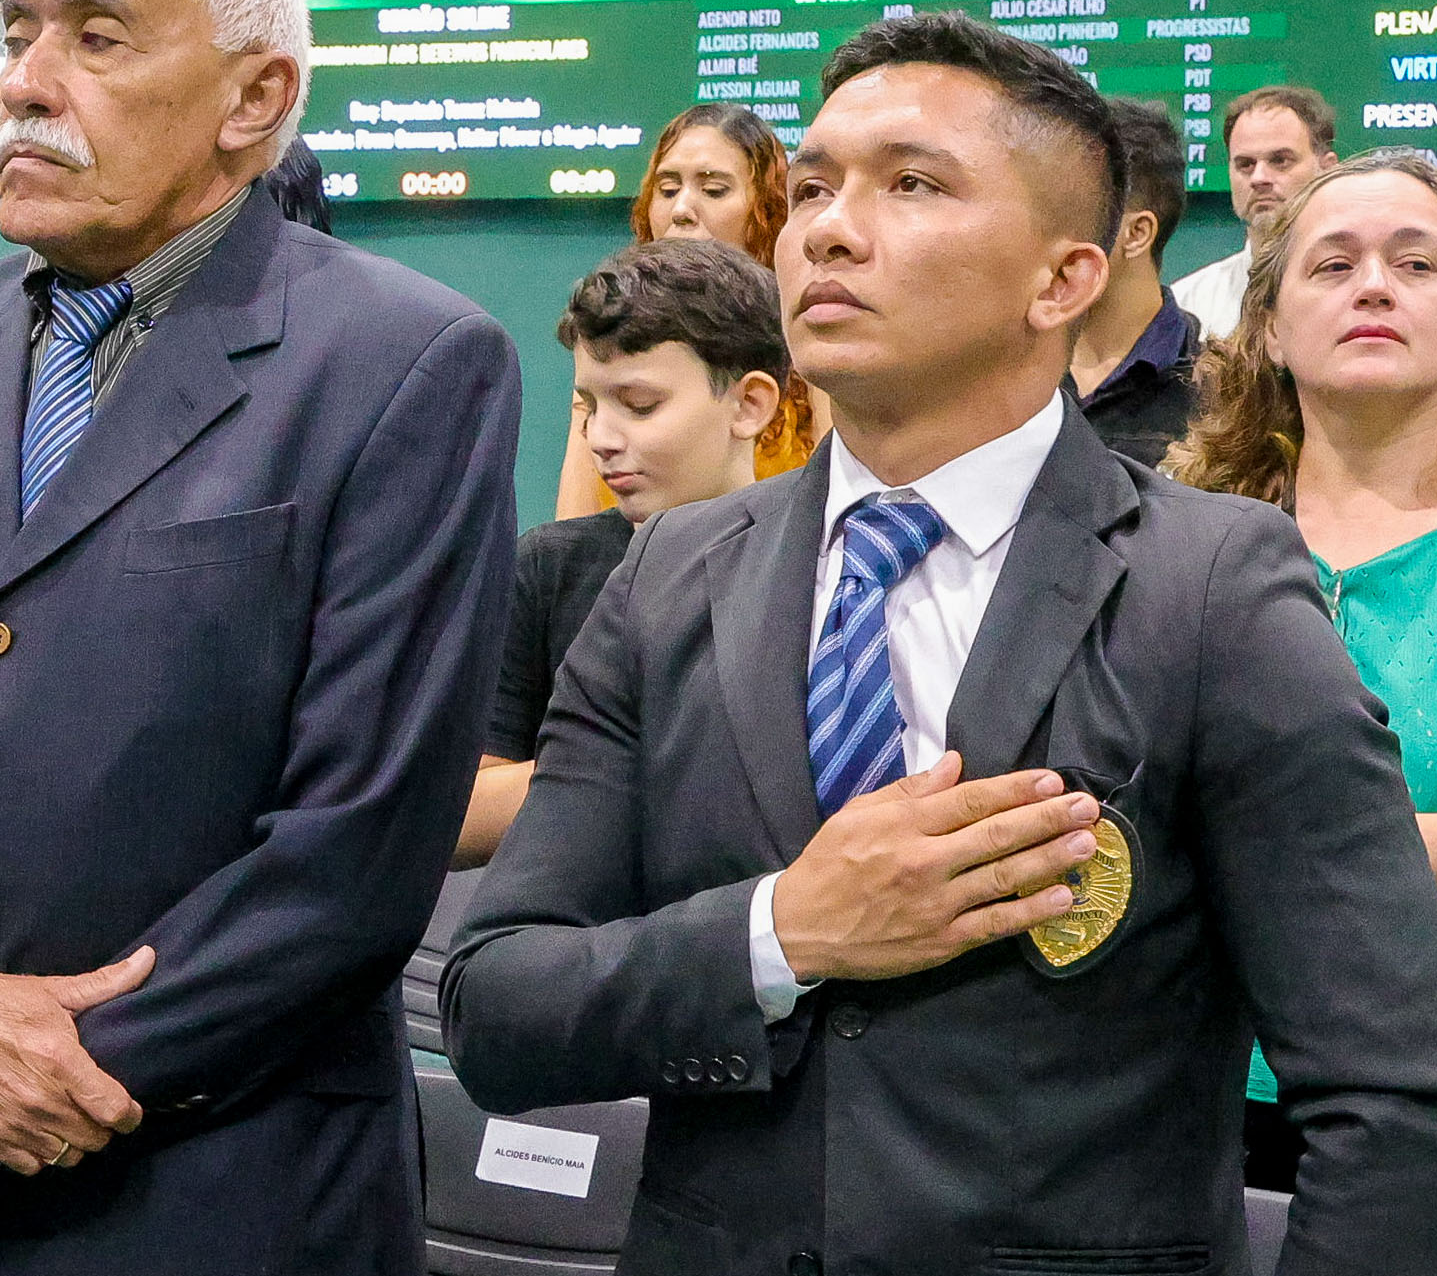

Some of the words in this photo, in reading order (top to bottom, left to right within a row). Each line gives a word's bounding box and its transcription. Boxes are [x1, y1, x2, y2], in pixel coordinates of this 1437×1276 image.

[401, 172, 467, 196] 00:00
[495, 1148, 530, 1161] ALCIDES
[531, 1154, 564, 1166] BENÍCIO
[565, 1159, 585, 1169] MAIA
